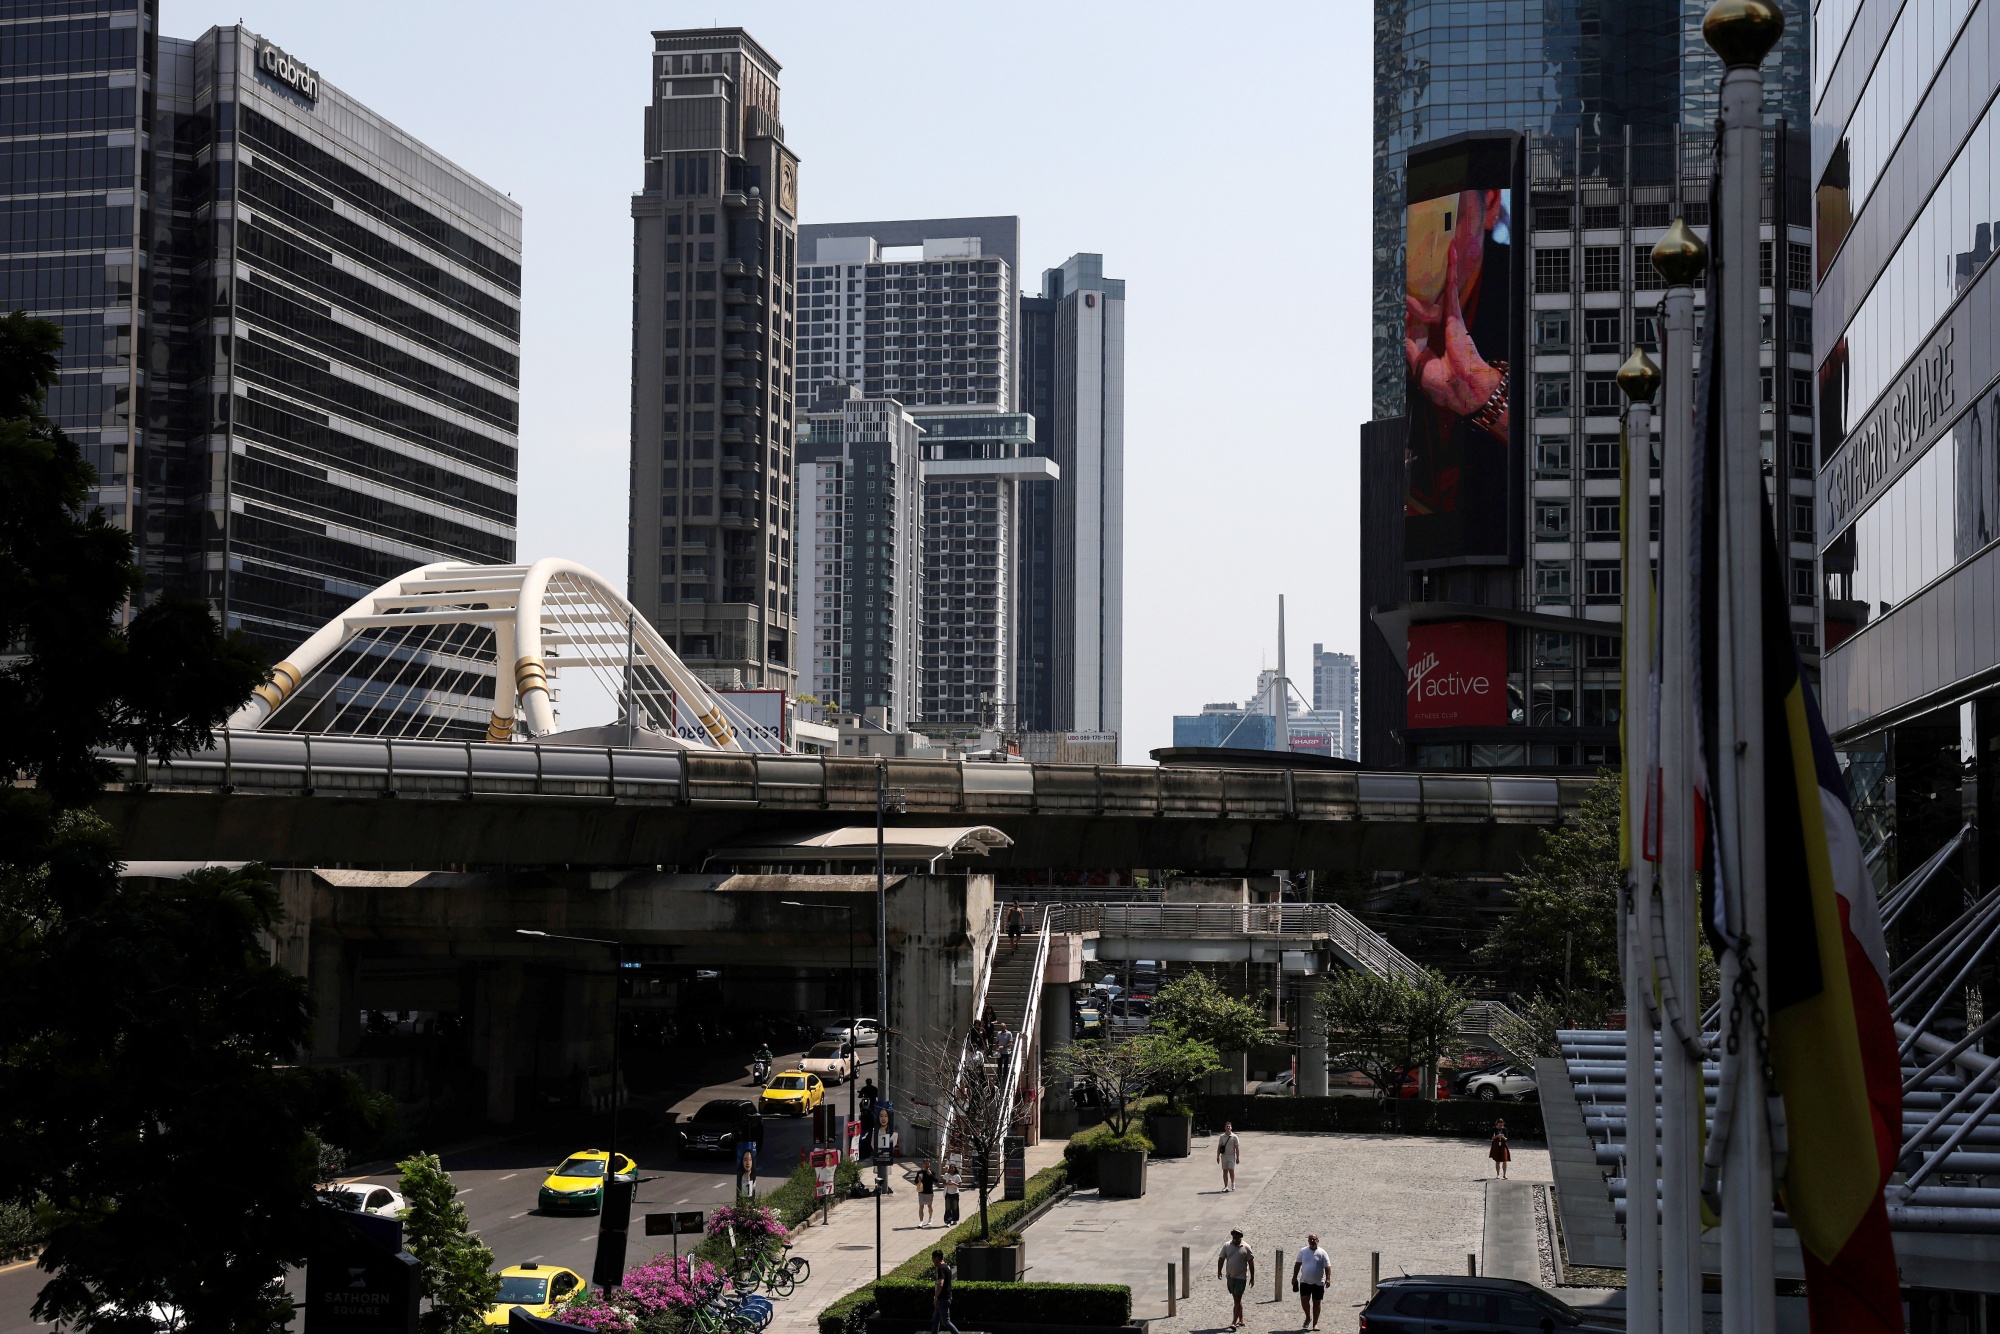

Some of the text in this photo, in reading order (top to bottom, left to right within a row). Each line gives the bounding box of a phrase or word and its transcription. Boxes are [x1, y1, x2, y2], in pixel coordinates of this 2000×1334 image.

[1835, 325, 1956, 523] SATHORN SQUARE
[1407, 650, 1440, 703] rgin
[1425, 671, 1490, 697] active
[1414, 711, 1458, 720] FITNESS CLUB
[825, 1184, 833, 1194] 7
[324, 1291, 390, 1304] SATHORN
[333, 1306, 381, 1316] SQUARE
